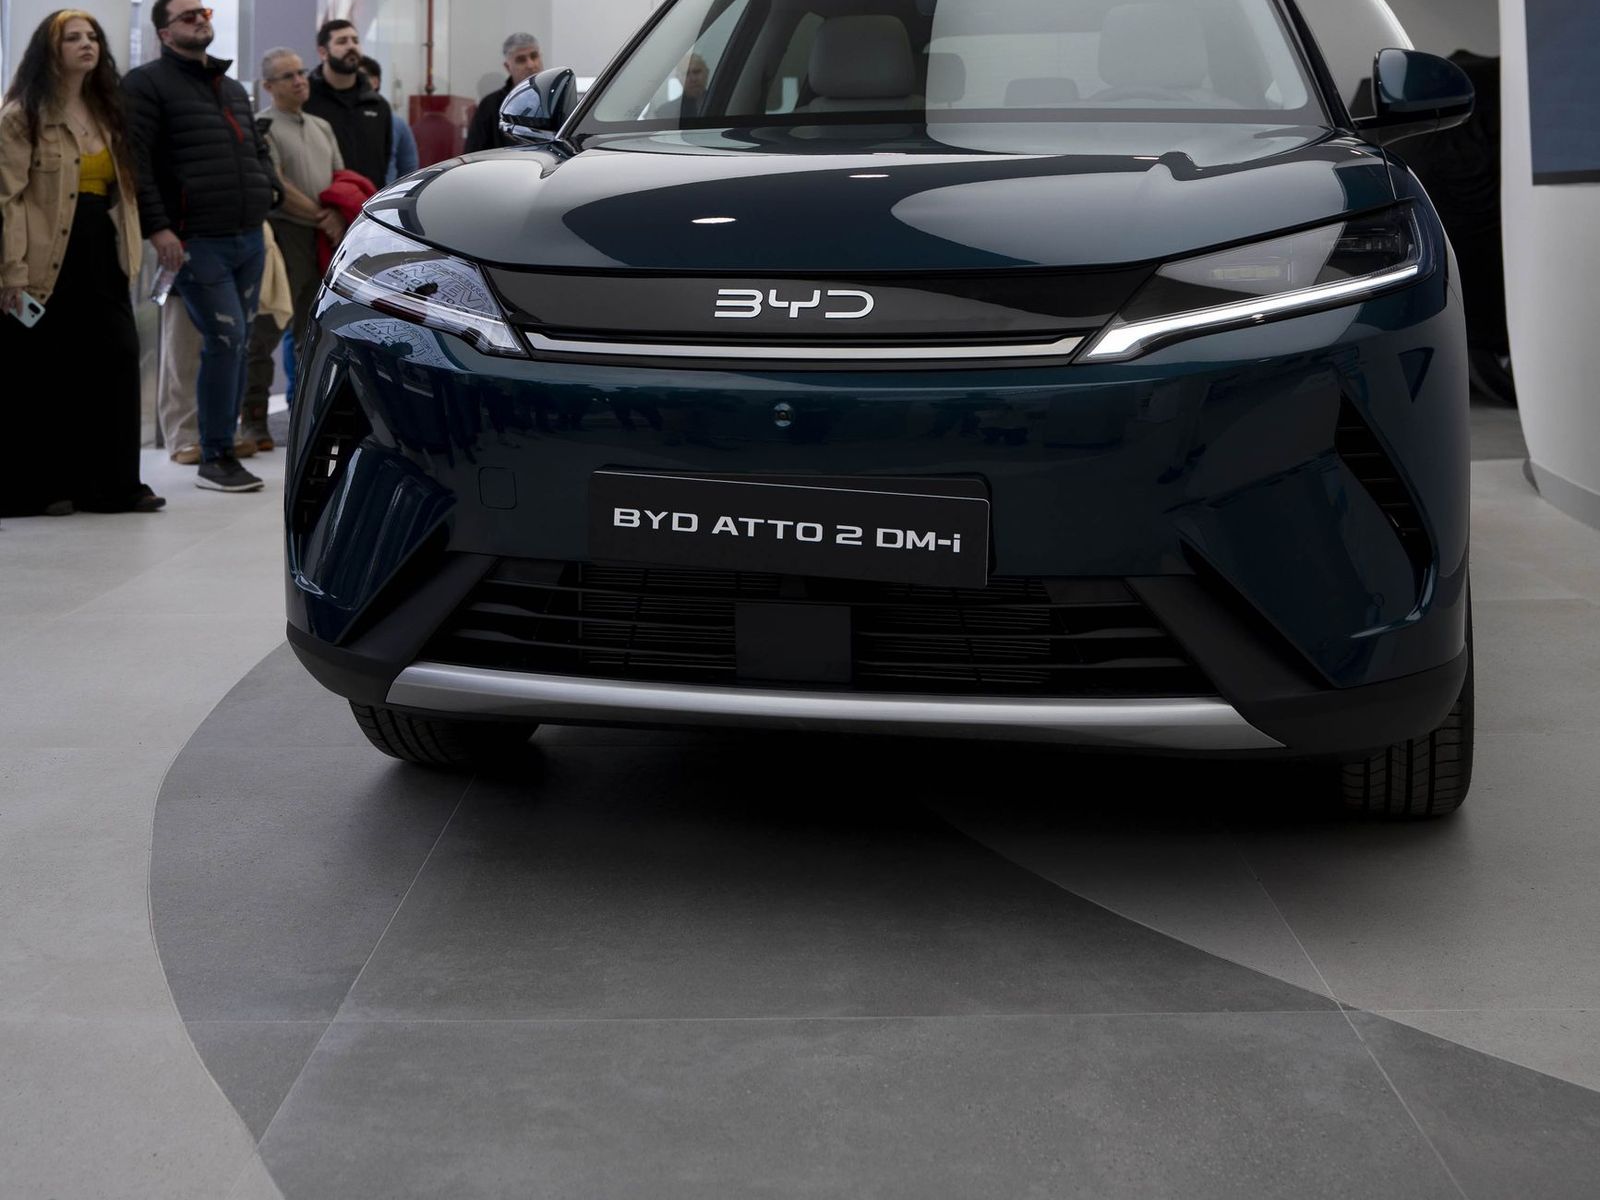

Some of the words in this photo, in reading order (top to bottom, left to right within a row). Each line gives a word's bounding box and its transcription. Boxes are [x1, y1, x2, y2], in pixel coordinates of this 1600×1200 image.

[714, 288, 875, 319] BYD
[613, 507, 699, 533] BYD
[711, 516, 823, 542] ATTO
[835, 524, 863, 546] 2
[876, 527, 961, 553] DM-i
